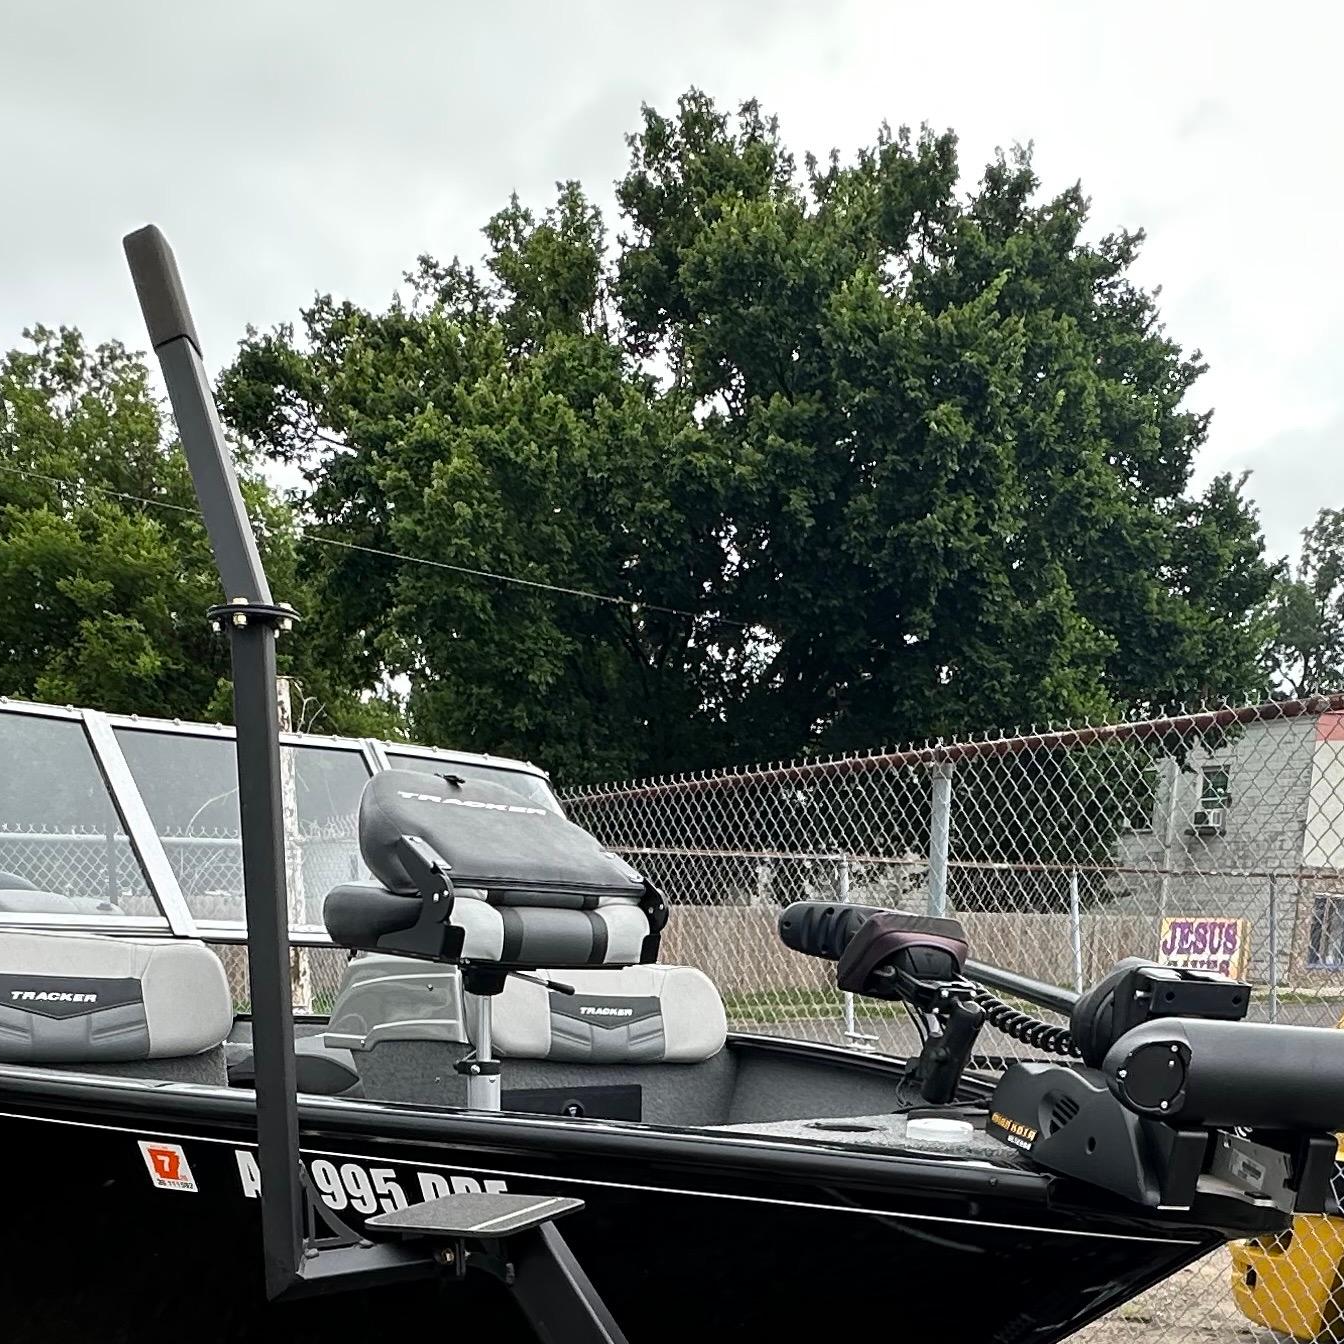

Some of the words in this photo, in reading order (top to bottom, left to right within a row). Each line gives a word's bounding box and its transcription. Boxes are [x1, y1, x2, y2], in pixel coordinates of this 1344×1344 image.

[1161, 922, 1237, 957] JESUS
[10, 990, 98, 1003] TRACKER
[579, 1006, 634, 1017] TRACKER
[156, 1154, 171, 1173] 7
[310, 1159, 409, 1215] 995
